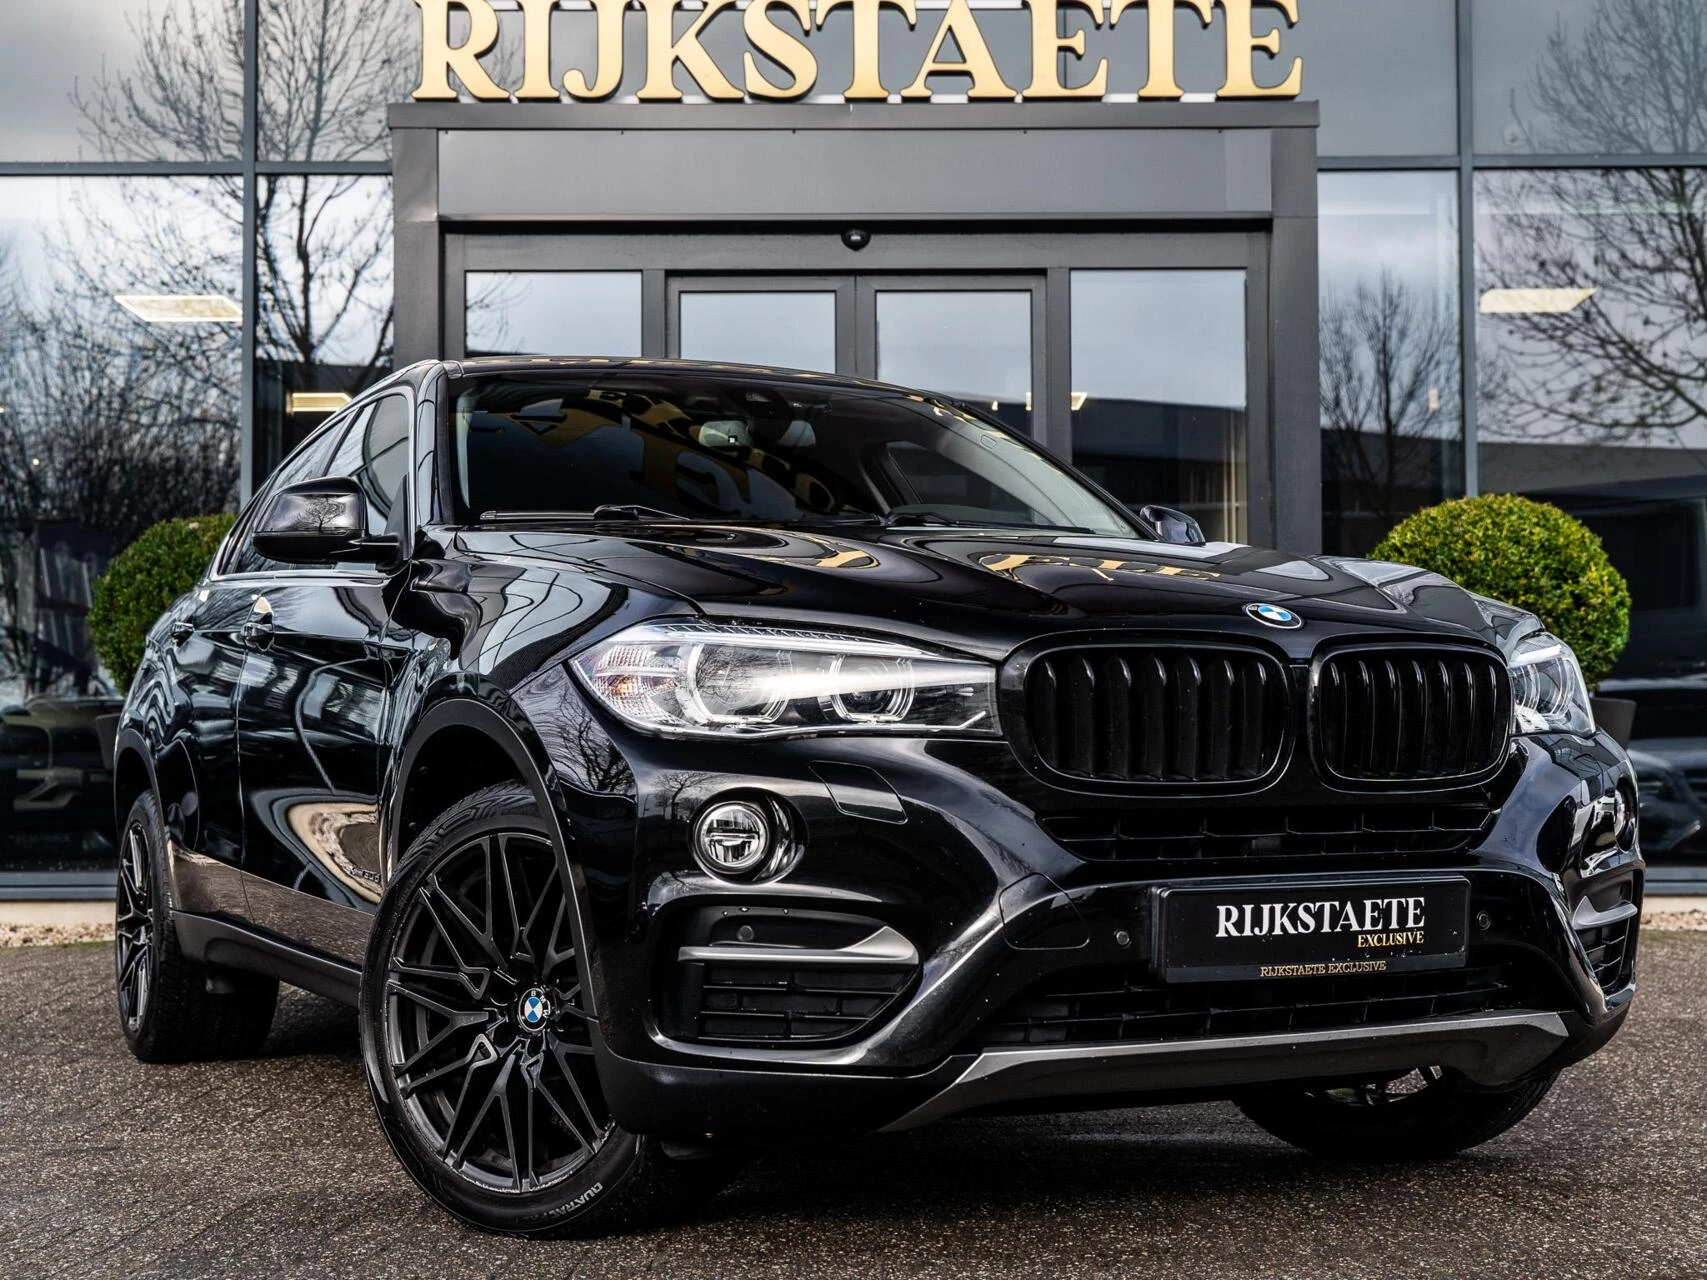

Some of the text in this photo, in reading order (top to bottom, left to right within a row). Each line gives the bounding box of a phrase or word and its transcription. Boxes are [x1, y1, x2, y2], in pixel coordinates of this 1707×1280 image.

[411, 0, 1303, 101] RIJKSTAETE
[1215, 897, 1425, 938] RIJKSTAETE
[1357, 930, 1425, 948] EXCLUSIVE
[1260, 960, 1387, 978] RIJKSTAETE EXCLUSIVE
[548, 1182, 603, 1219] QUATRAC
